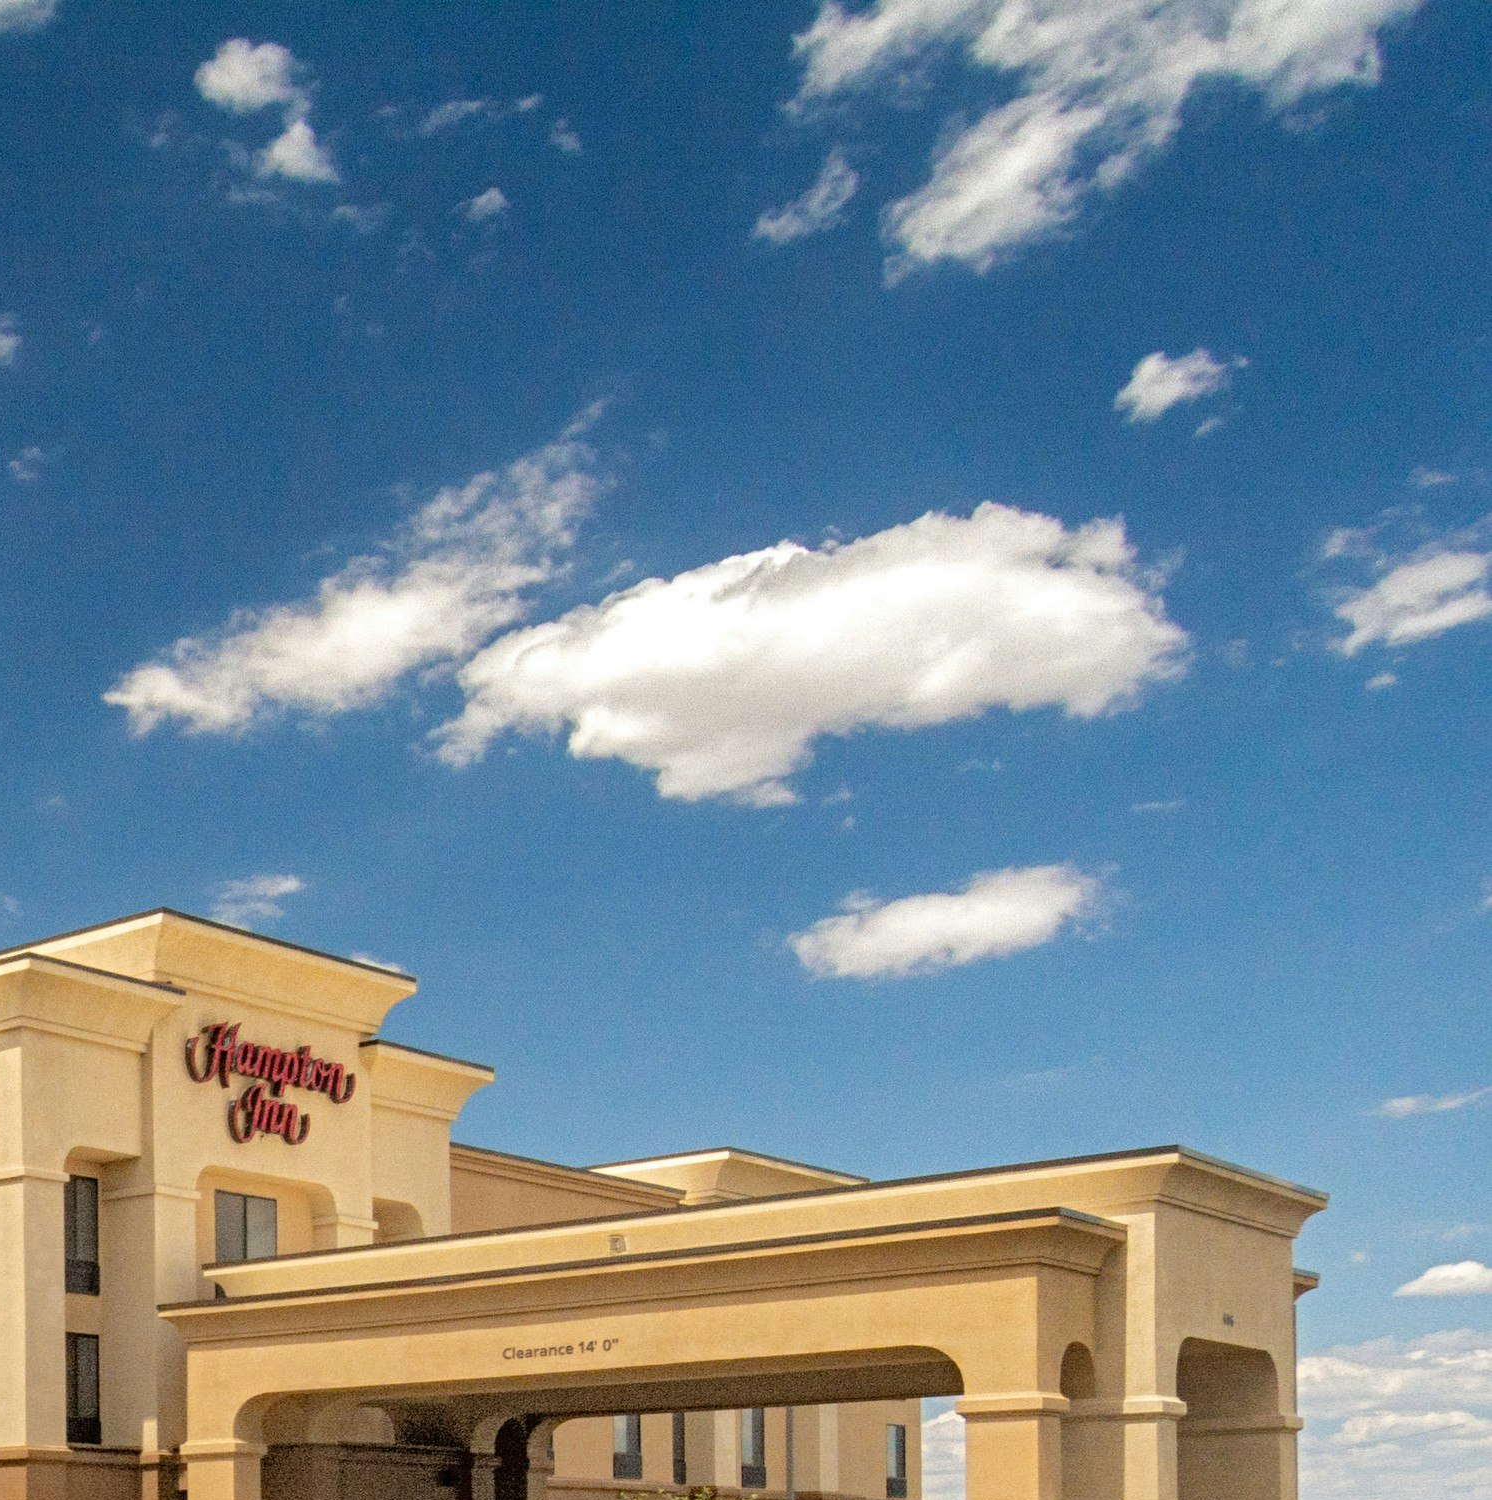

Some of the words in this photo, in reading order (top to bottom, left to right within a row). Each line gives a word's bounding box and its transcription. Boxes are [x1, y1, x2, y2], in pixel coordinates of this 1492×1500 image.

[185, 1022, 356, 1104] Hampton
[228, 1083, 310, 1144] Inn
[502, 1344, 574, 1360] Clearance
[578, 1341, 598, 1353] 14'
